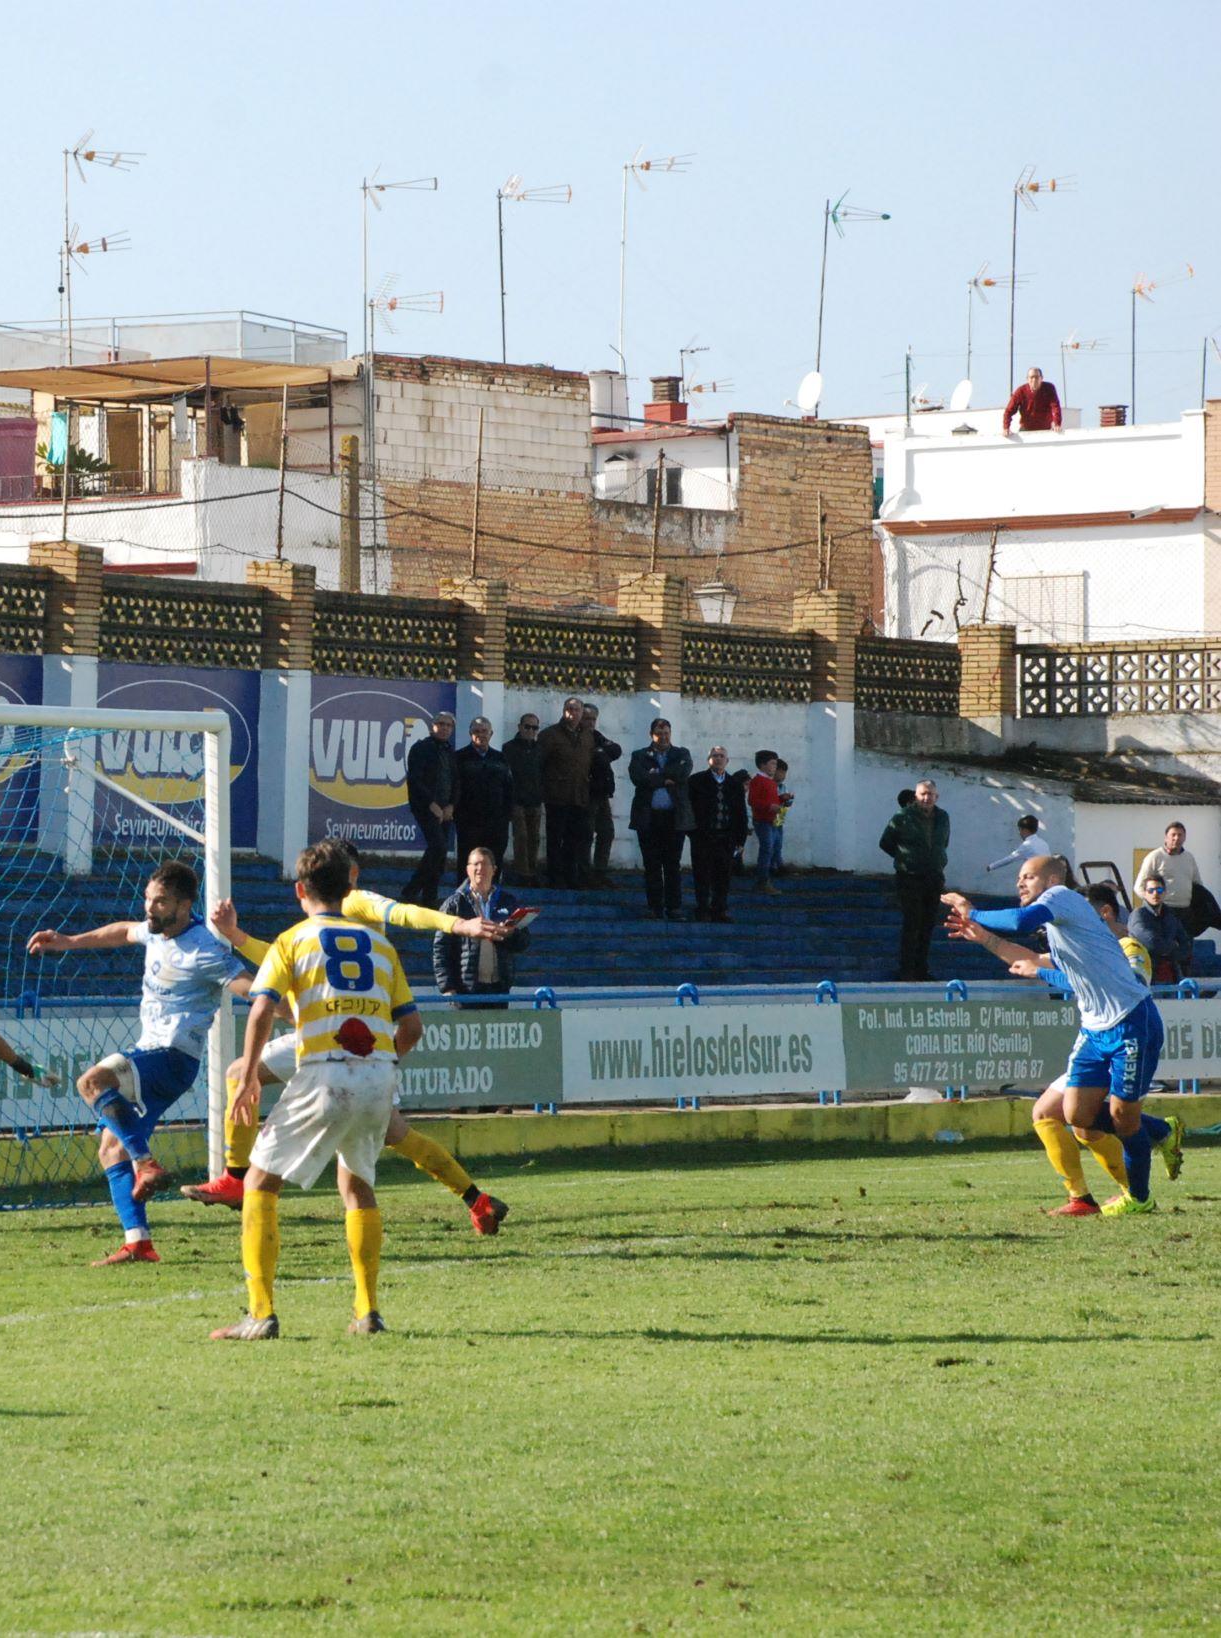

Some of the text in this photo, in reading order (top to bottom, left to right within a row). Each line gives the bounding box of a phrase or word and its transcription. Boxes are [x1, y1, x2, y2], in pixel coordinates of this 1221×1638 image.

[324, 818, 417, 842] Sevineumáticos
[318, 927, 375, 992] 8
[858, 1008, 882, 1030] Pol.
[884, 1008, 907, 1029] Ind.
[910, 1008, 925, 1028] La
[927, 1007, 971, 1028] Estrella
[1033, 1010, 1059, 1027] nave
[1060, 1006, 1075, 1026] 30
[455, 1023, 482, 1050] DE
[485, 1021, 542, 1049] HIELO
[906, 1034, 941, 1056] CORIA
[943, 1033, 965, 1055] DEL
[988, 1033, 1033, 1057] (Sevilla)
[588, 1023, 814, 1080] www.hielosdelsur.es
[1124, 1037, 1139, 1081] XEREZ
[395, 1065, 494, 1096] RITURADO
[894, 1062, 908, 1083] 95
[910, 1061, 931, 1082] 477
[934, 1061, 949, 1081] 22
[952, 1061, 964, 1080] 11
[975, 1060, 995, 1081] 672
[997, 1060, 1011, 1080] 63
[1013, 1059, 1027, 1079] 06
[1030, 1059, 1044, 1079] 87
